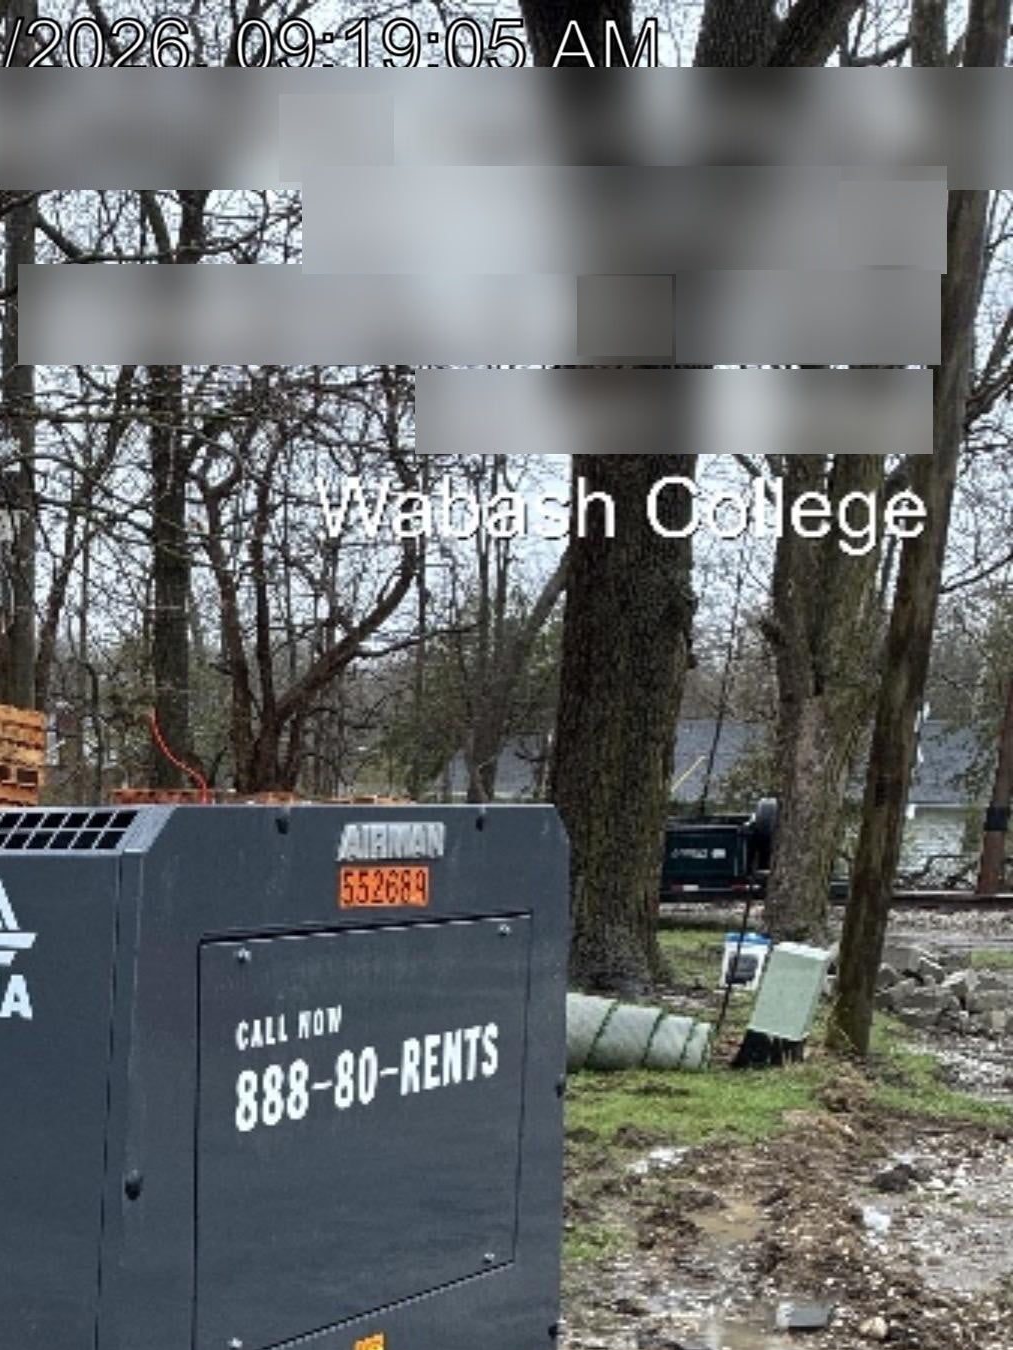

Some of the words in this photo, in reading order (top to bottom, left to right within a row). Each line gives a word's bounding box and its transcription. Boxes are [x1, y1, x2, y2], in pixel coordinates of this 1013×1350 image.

[337, 821, 446, 861] AIRMAN
[343, 868, 426, 904] 552689
[235, 1013, 289, 1051] CALL
[297, 1004, 343, 1039] NOW
[235, 1022, 499, 1132] 888-80-RENTS
